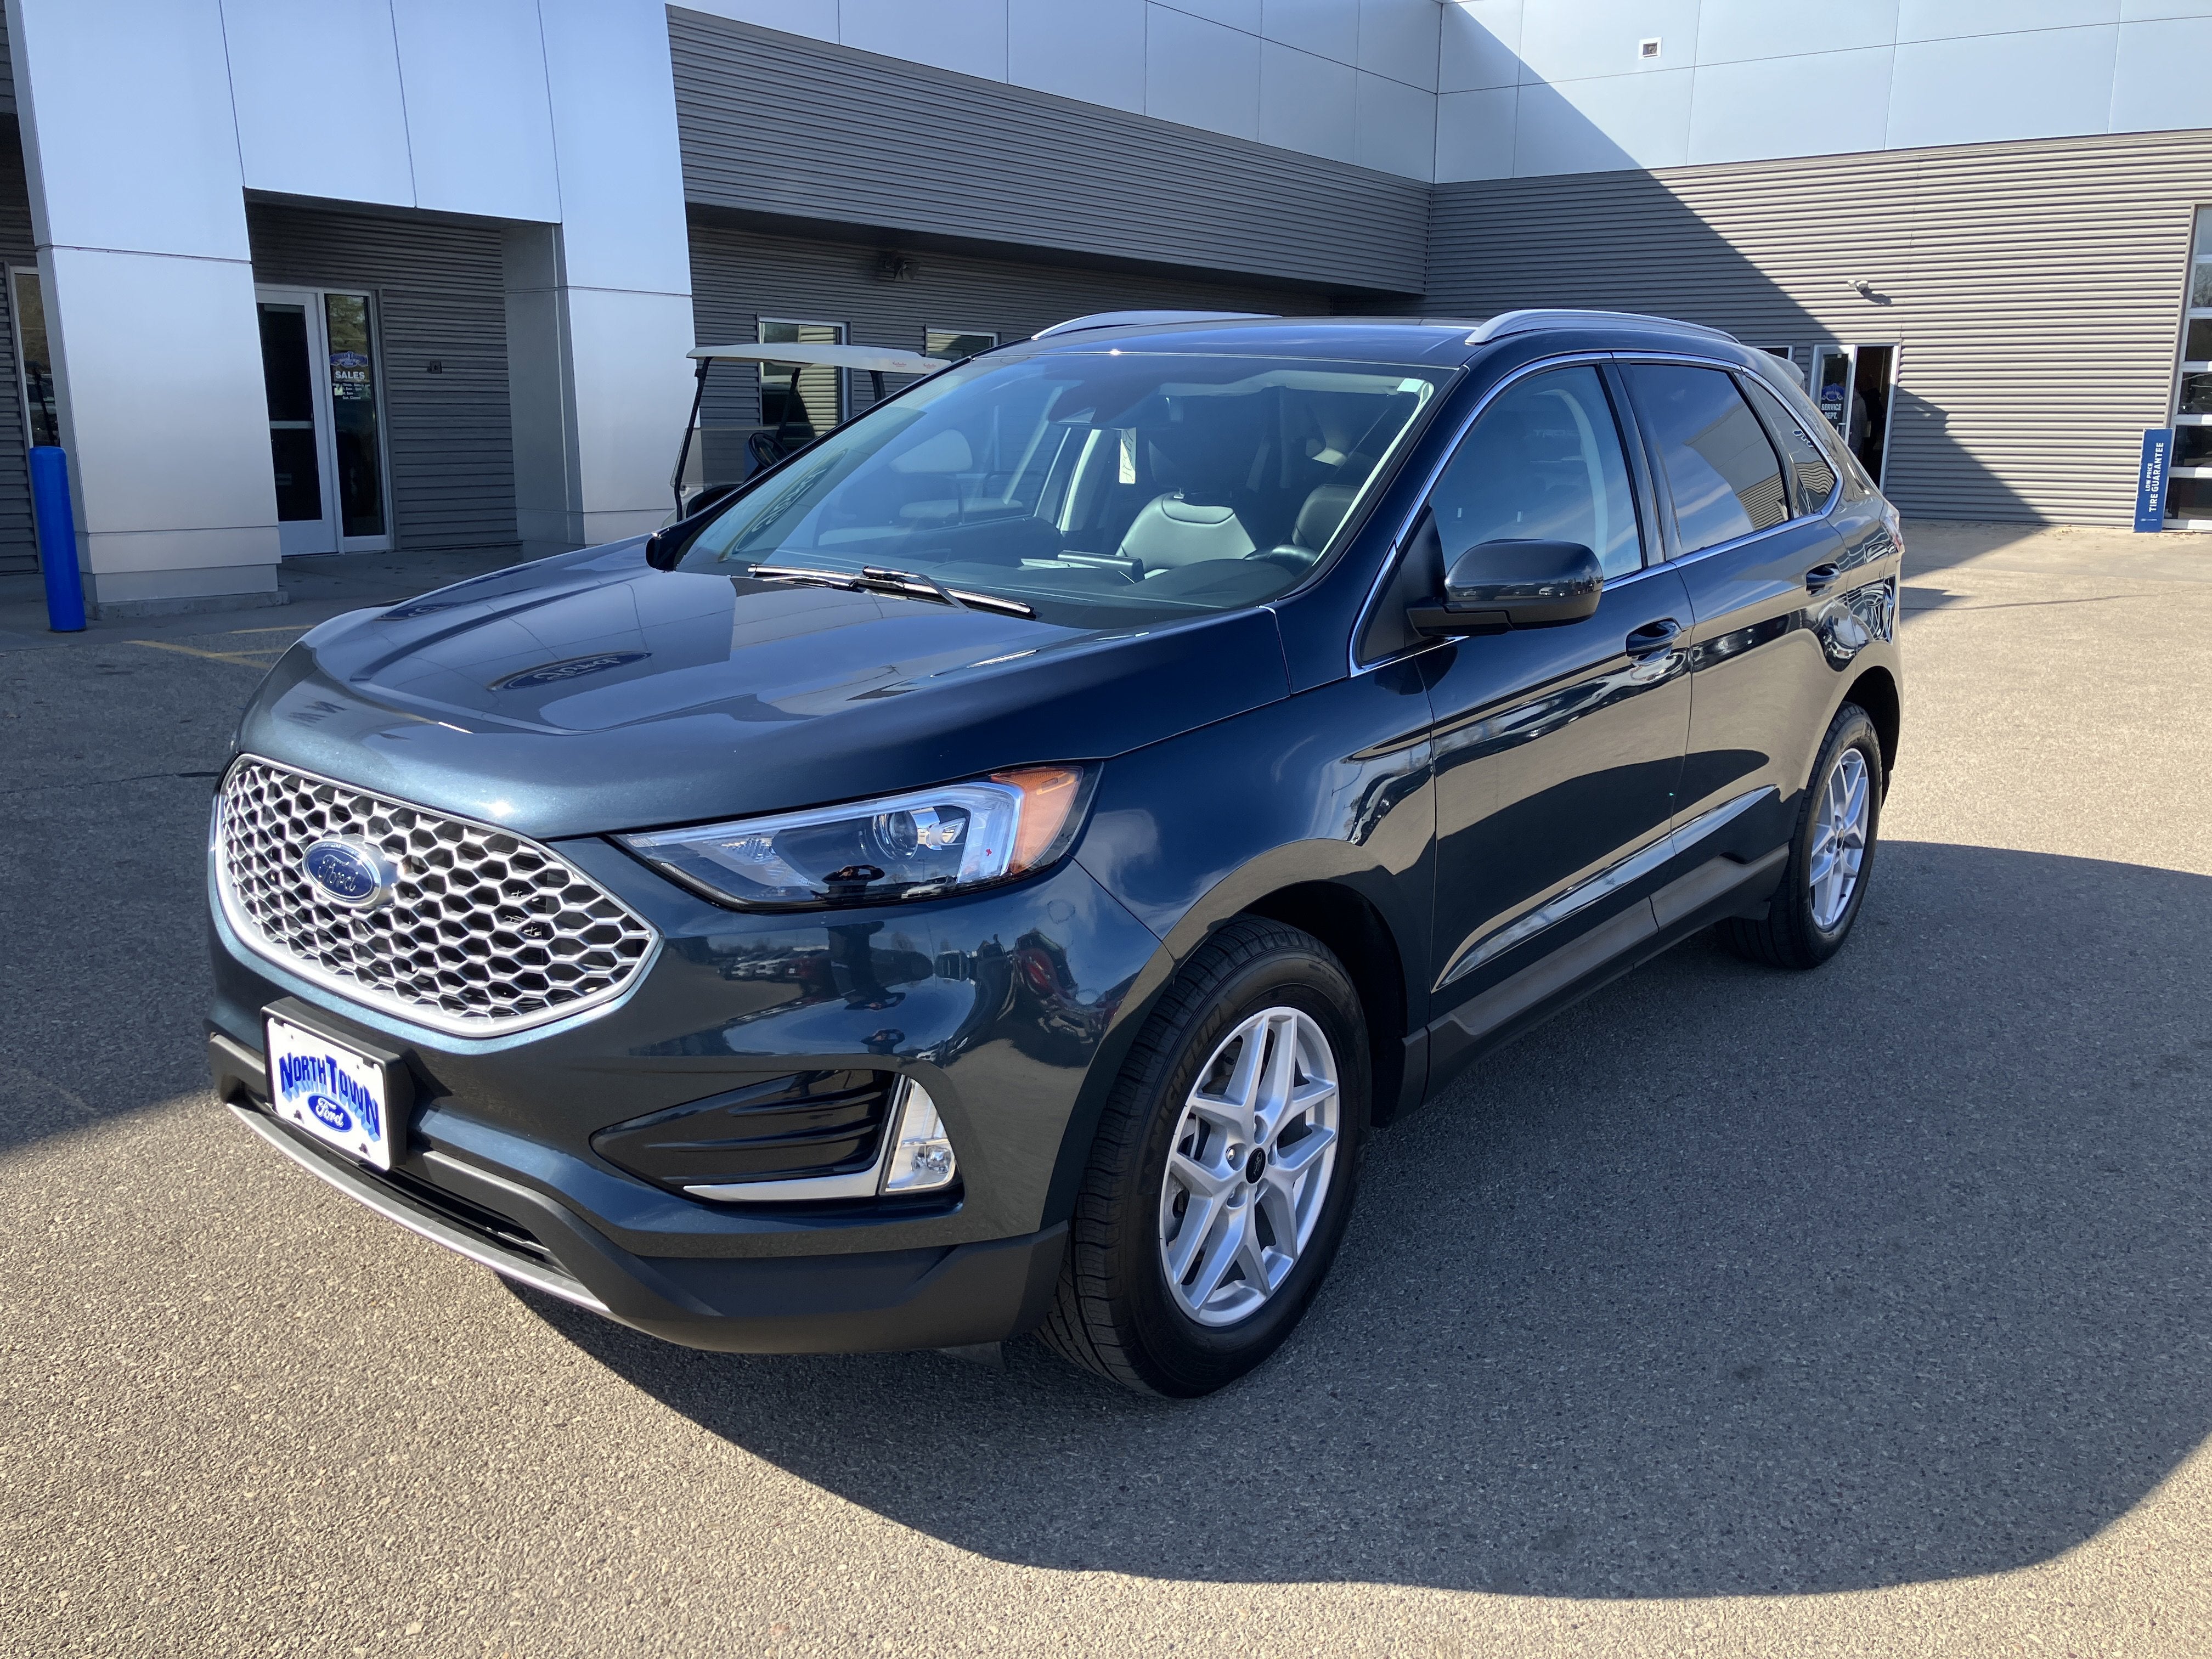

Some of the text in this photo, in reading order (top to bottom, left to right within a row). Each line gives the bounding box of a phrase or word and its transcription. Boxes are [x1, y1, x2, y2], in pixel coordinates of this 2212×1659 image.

[335, 371, 365, 379] SALES
[2151, 442, 2164, 492] GUARANTEE
[2149, 494, 2158, 512] TIRE
[318, 854, 358, 893] Ford
[315, 1097, 344, 1127] Ford
